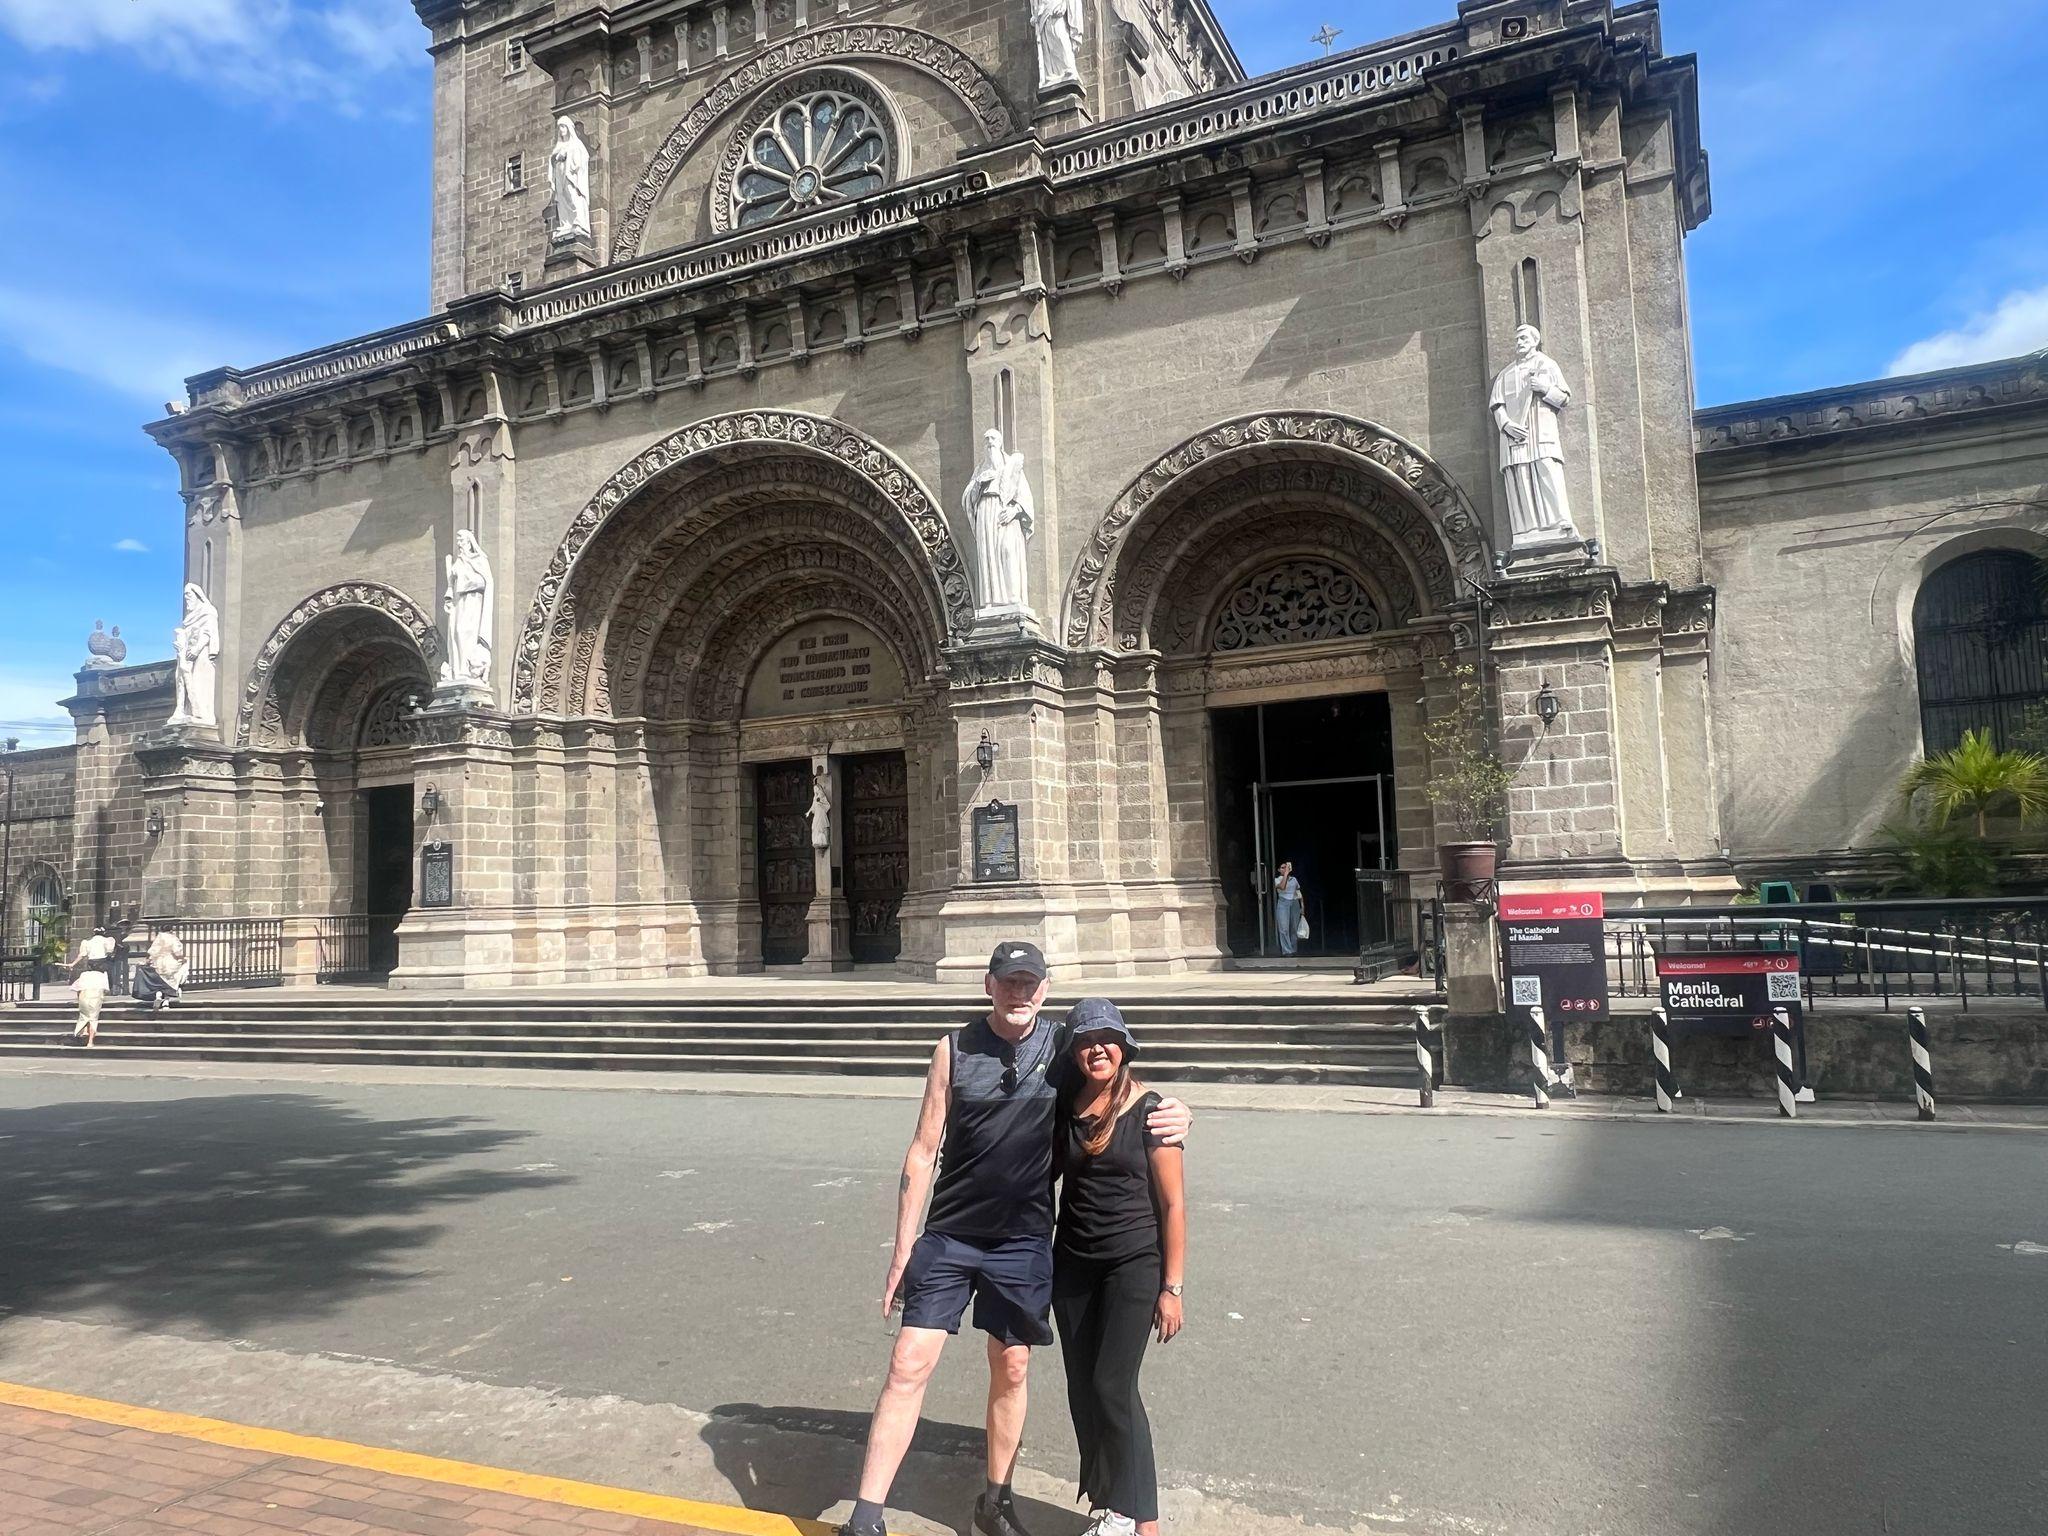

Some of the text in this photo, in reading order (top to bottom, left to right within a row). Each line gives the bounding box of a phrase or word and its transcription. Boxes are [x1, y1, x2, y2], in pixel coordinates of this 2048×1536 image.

[1524, 926, 1560, 934] Cathedral
[1668, 981, 1720, 995] Manila
[1669, 994, 1744, 1008] Cathedral
